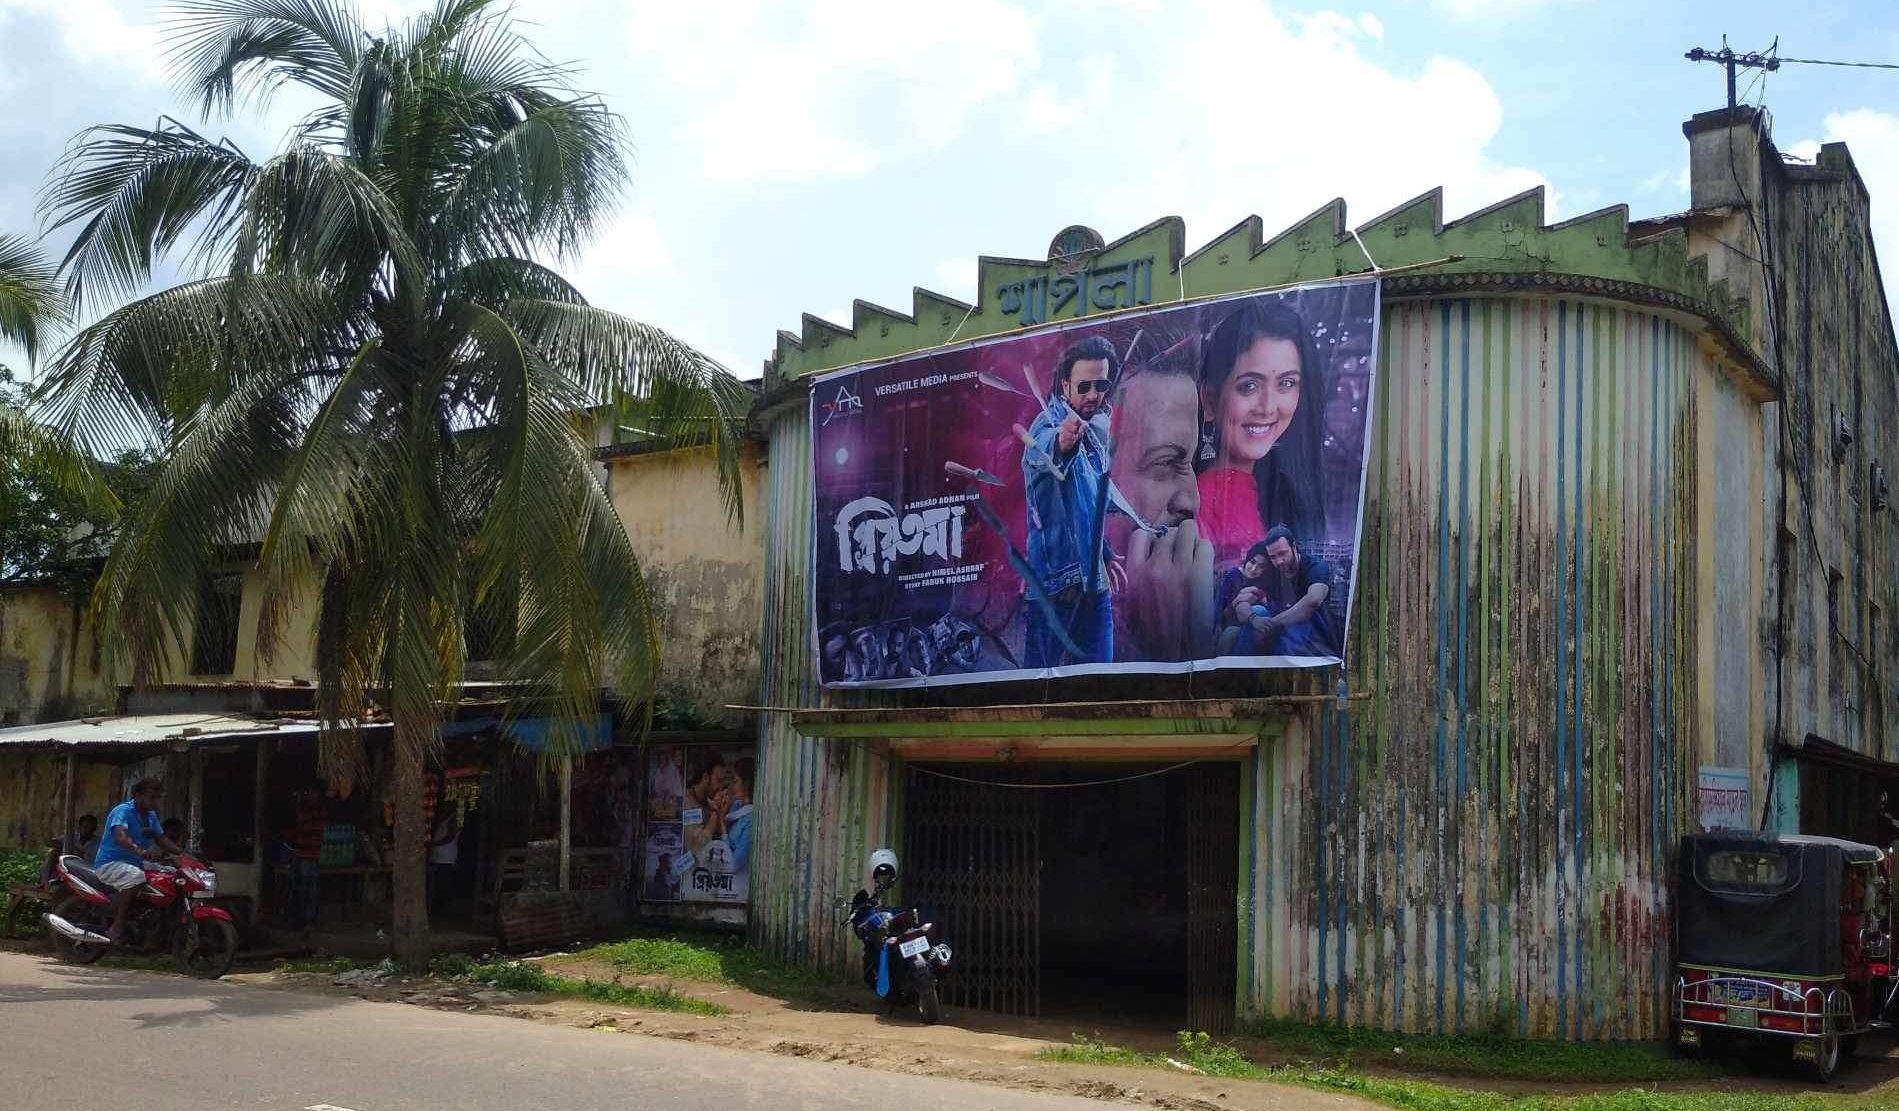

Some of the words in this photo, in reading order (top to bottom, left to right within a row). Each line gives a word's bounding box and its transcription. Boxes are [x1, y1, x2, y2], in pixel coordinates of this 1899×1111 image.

[875, 379, 919, 397] VERSATILE
[920, 374, 948, 388] MEDIA
[949, 371, 978, 382] PRESENTS
[939, 494, 966, 505] ADNAN
[946, 573, 978, 585] HOSSAIN
